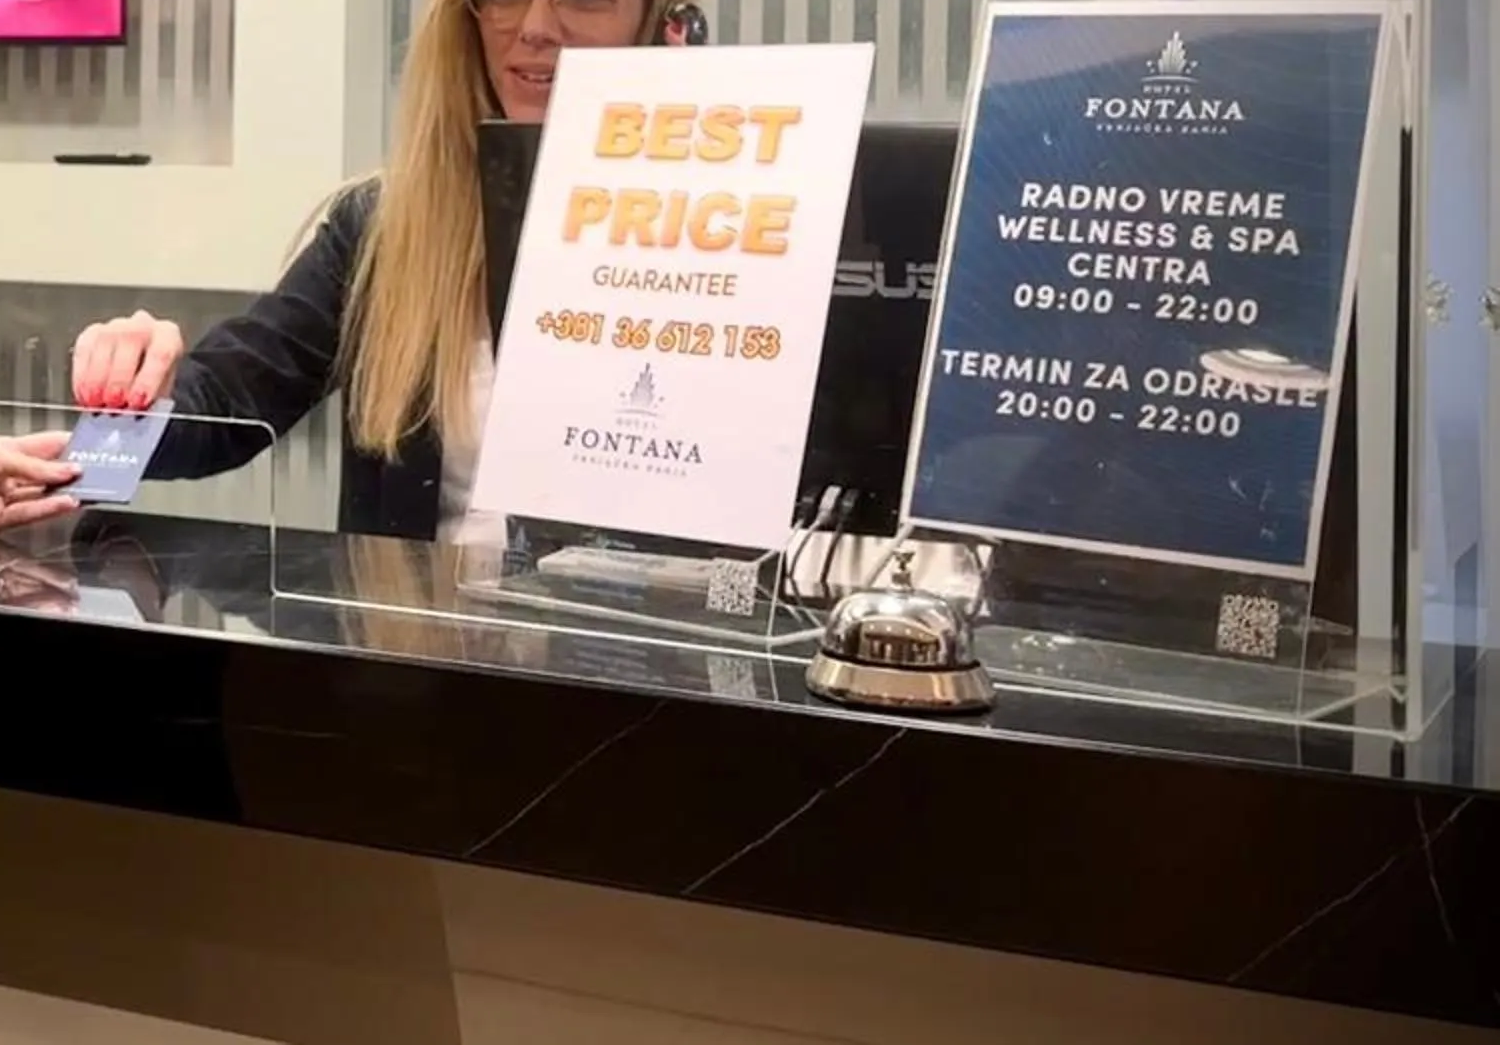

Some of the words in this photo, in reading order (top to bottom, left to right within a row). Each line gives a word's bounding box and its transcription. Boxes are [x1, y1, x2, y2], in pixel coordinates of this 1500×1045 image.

[1083, 97, 1246, 121] FONTANA
[595, 102, 803, 164] BEST
[562, 185, 797, 257] PRICE
[1020, 182, 1146, 214] RADNO
[1158, 187, 1286, 221] VREME
[997, 214, 1178, 249] WELLNESS
[1190, 223, 1214, 252] &
[1227, 225, 1301, 257] SPA
[591, 265, 738, 297] GUARANTEE
[1066, 251, 1212, 287] CENTRA
[1013, 283, 1114, 314] 09:00
[1154, 293, 1260, 326] 22:00
[535, 309, 605, 345] +381
[611, 316, 652, 350] 36
[655, 319, 714, 356] 612
[723, 324, 781, 360] 153
[940, 347, 1073, 387] TERMIN
[1084, 361, 1130, 392] ZA
[1143, 366, 1319, 408] ODRASLE
[996, 389, 1097, 424] 20:00
[1137, 403, 1241, 438] 22:00
[563, 426, 704, 464] FONTANA
